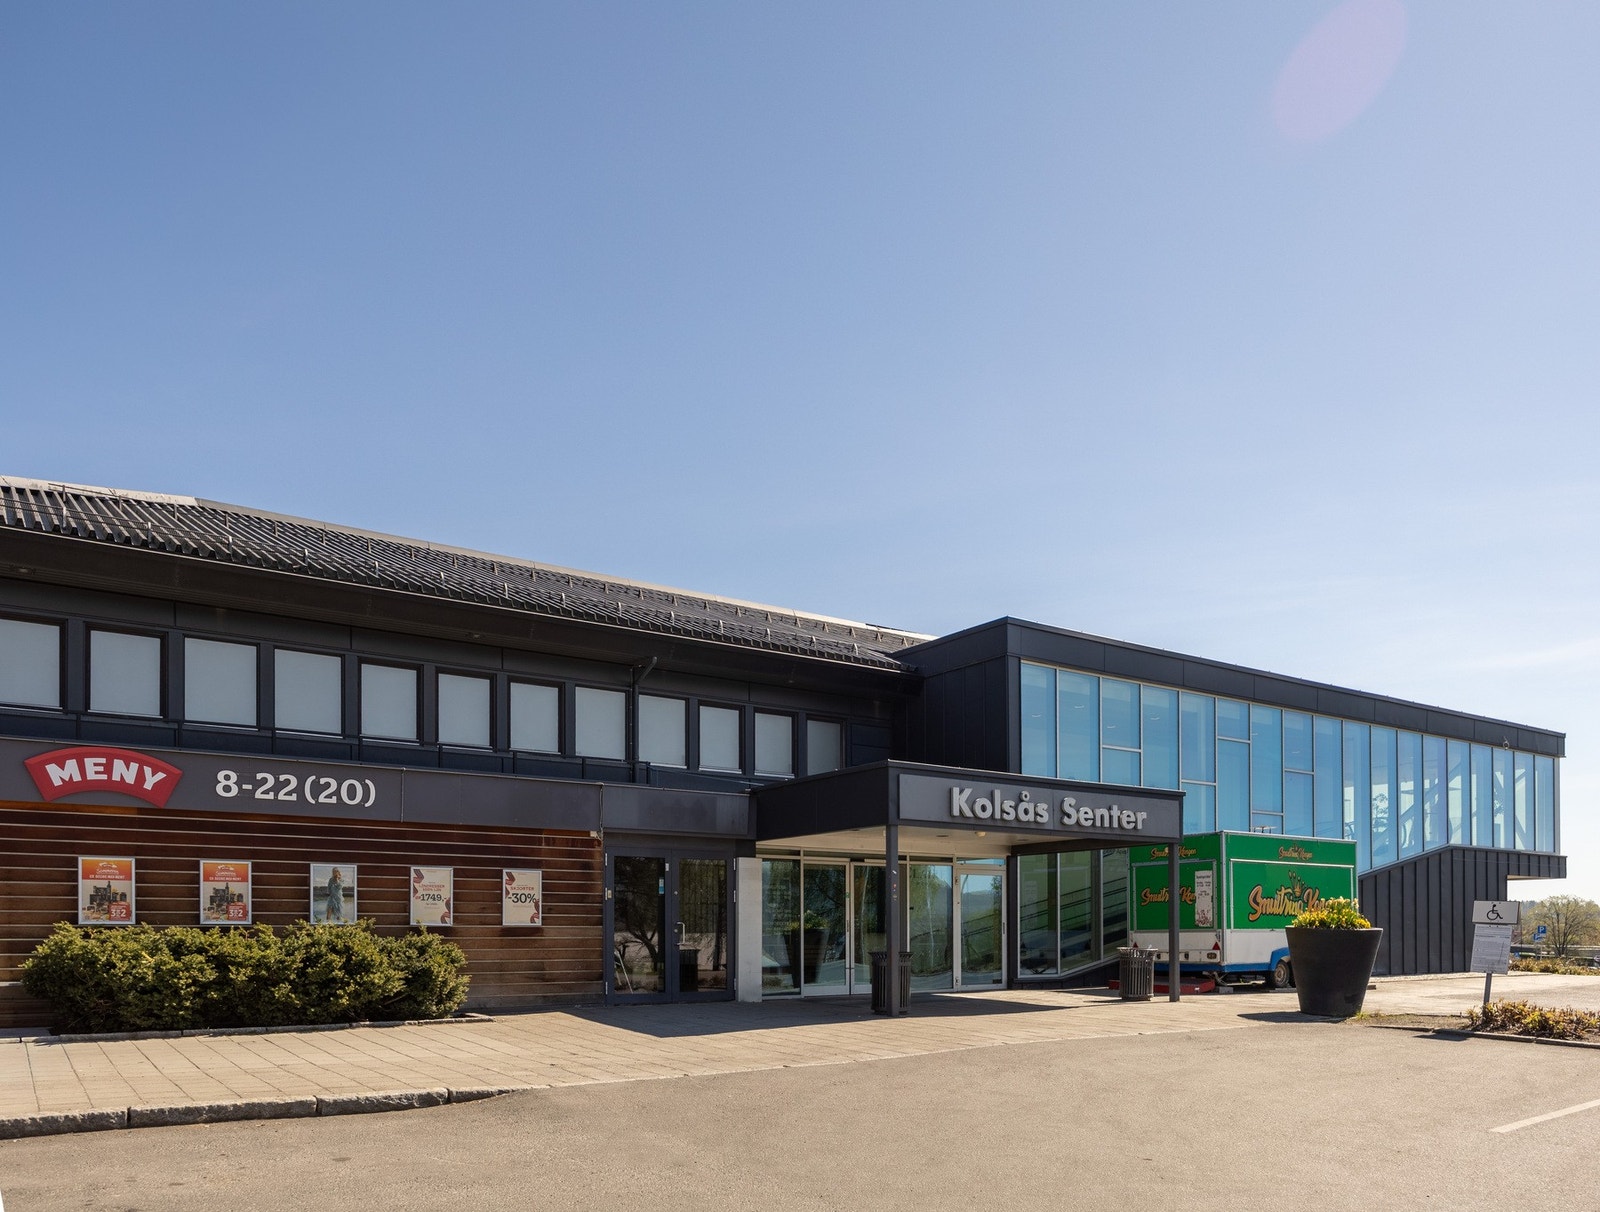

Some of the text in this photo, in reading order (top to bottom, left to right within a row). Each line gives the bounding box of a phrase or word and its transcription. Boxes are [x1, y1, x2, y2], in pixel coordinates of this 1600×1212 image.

[45, 757, 167, 791] MENY
[951, 786, 1147, 830] Kolsås Senter
[507, 892, 537, 903] -30%
[120, 909, 127, 917] 2
[237, 909, 244, 917] 2
